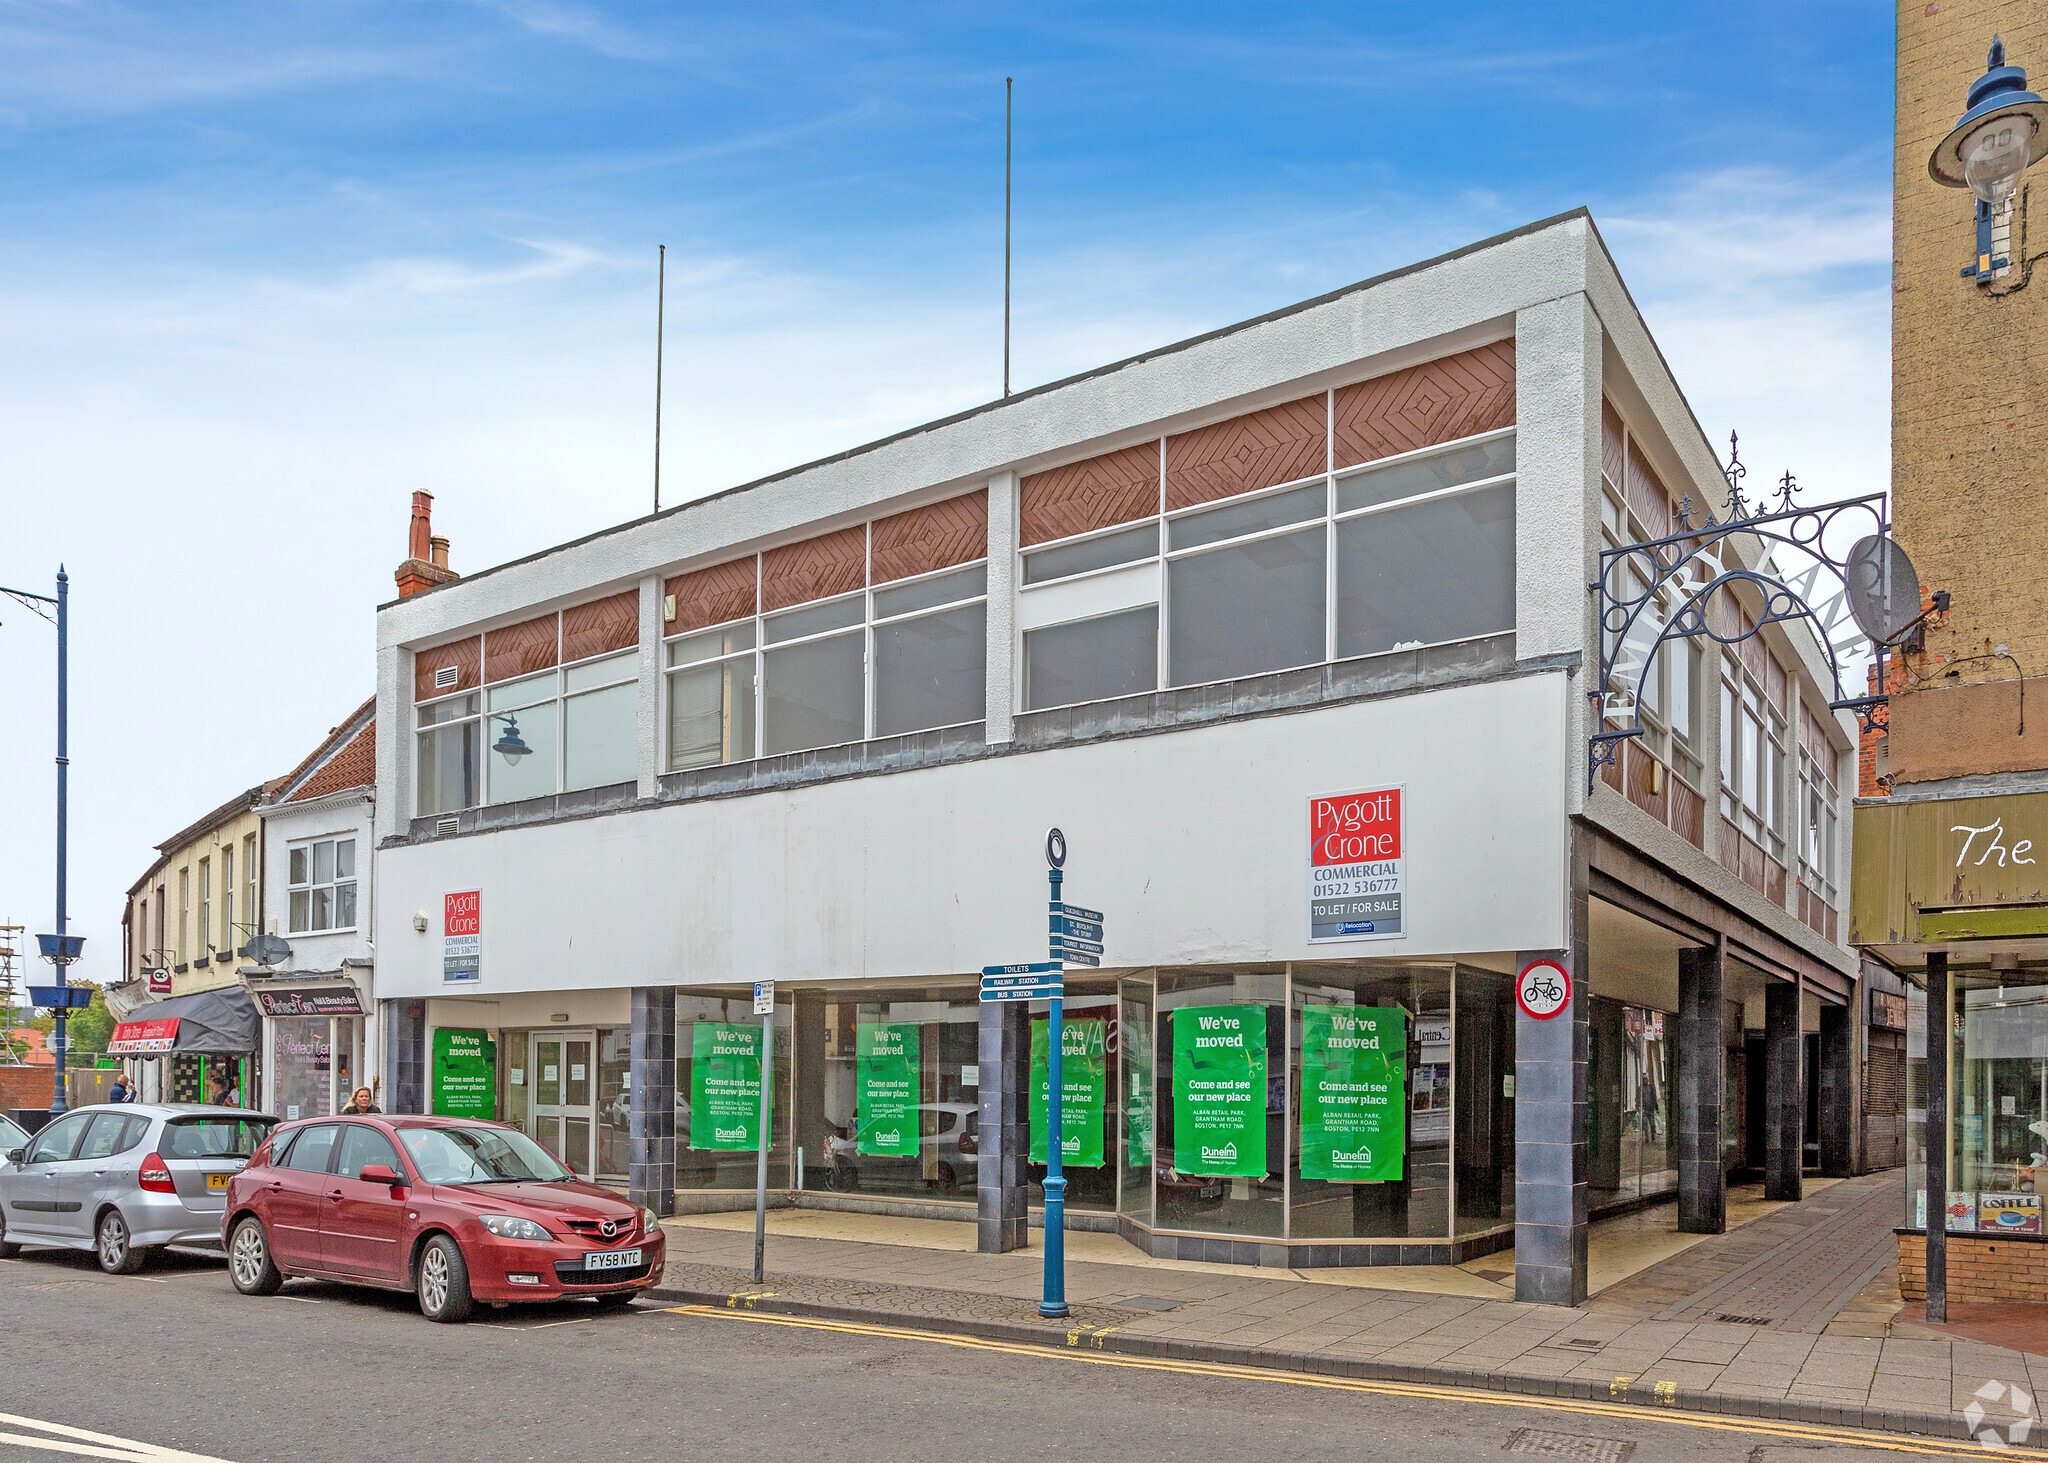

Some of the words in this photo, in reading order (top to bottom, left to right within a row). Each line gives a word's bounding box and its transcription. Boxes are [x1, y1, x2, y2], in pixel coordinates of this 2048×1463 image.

[1318, 794, 1393, 832] Pygott
[1324, 833, 1393, 860] Crone
[1950, 817, 2036, 867] The
[1314, 862, 1398, 882] COMMERCIAL
[1313, 882, 1349, 897] 01522
[1354, 878, 1398, 894] 536777
[447, 893, 477, 916] Pygott
[1313, 905, 1326, 916] TO
[1328, 904, 1345, 915] LET
[1352, 902, 1371, 914] FOR
[1373, 900, 1399, 912] SALE
[450, 916, 477, 933] Crone
[445, 935, 479, 946] COMMERCIAL
[445, 947, 460, 955] 01522
[461, 946, 479, 954] 536777
[468, 958, 478, 966] SALE
[1003, 965, 1029, 973] TOILETS
[1012, 990, 1033, 998] STATION
[261, 993, 299, 1014] Perfect
[290, 994, 318, 1014] Ten
[1198, 1016, 1240, 1030] We've
[1331, 1016, 1377, 1032] We've
[451, 1035, 480, 1045] We've
[716, 1031, 752, 1042] We've
[874, 1031, 901, 1042] We've
[1061, 1031, 1084, 1040] e've
[1196, 1034, 1243, 1048] moved
[282, 1034, 314, 1055] Perfect
[1327, 1036, 1380, 1050] moved
[449, 1048, 481, 1056] moved
[713, 1045, 754, 1056] moved
[872, 1045, 904, 1055] moved
[1061, 1044, 1086, 1056] oved
[705, 1078, 729, 1086] Come
[730, 1078, 745, 1086] and
[867, 1080, 886, 1088] Come
[886, 1080, 898, 1088] and
[1064, 1082, 1078, 1091] and
[1189, 1080, 1215, 1089] Come
[1216, 1080, 1234, 1089] and
[1235, 1081, 1250, 1089] see
[1319, 1081, 1349, 1092] Come
[1349, 1081, 1369, 1092] and
[1370, 1084, 1388, 1092] see
[738, 1088, 760, 1097] place
[893, 1090, 909, 1098] place
[1188, 1093, 1204, 1101] our
[1206, 1093, 1225, 1101] new
[1226, 1092, 1251, 1103] place
[1072, 1094, 1092, 1103] place
[1318, 1095, 1336, 1104] our
[1337, 1096, 1359, 1104] new
[1360, 1095, 1388, 1106] place
[716, 1127, 746, 1137] Dunelm
[1324, 1125, 1350, 1133] BOSTON,
[876, 1131, 900, 1141] Dunelm
[1201, 1145, 1236, 1157] Dunelm
[1332, 1149, 1370, 1161] Dunelm
[1983, 1198, 2038, 1209] COFFEE
[591, 1254, 619, 1268] FY58
[621, 1252, 638, 1265] NTC
